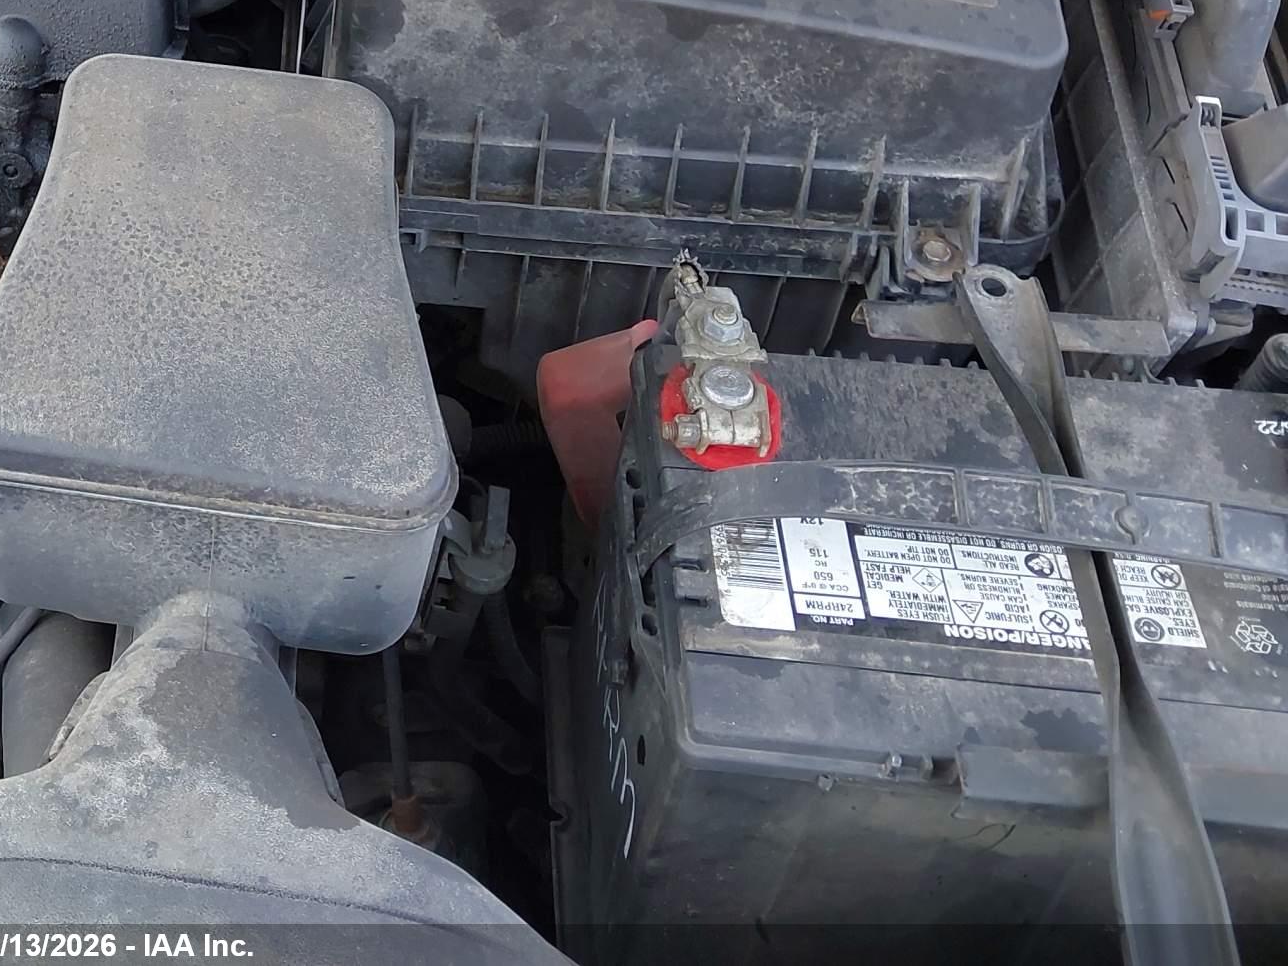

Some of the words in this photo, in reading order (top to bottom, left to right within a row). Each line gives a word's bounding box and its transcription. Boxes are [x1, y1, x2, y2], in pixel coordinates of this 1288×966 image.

[918, 533, 967, 545] DISASSEMBLE
[810, 548, 828, 558] 115
[863, 548, 898, 559] BATTERY.
[905, 545, 917, 553] TIP.
[920, 546, 935, 554] NOT
[937, 548, 948, 556] DO
[900, 552, 919, 561] OPEN
[923, 554, 937, 563] NOT
[940, 556, 950, 565] DO
[862, 562, 885, 572] FAST.
[983, 560, 996, 569] ALL
[999, 561, 1019, 571] READ
[1120, 565, 1144, 574] REACH
[889, 565, 910, 575] HELP
[813, 571, 832, 582] 650
[863, 571, 903, 582] MEDICAL
[957, 572, 986, 584] BURNS.
[989, 576, 1018, 586] SEVERE
[1130, 574, 1148, 583] KEEP
[830, 583, 848, 592] CCA
[866, 580, 882, 589] GET
[964, 581, 975, 590] OR
[977, 583, 1020, 595] BLINDNESS
[885, 590, 919, 601] WATER.
[922, 593, 945, 603] WITH
[979, 592, 1004, 601] CAUSE
[1008, 595, 1023, 603] CAN
[1175, 591, 1186, 600] OR
[888, 598, 947, 612] IMMEDIATELY
[1048, 601, 1078, 611] SPARKS
[1146, 596, 1170, 606] CAUSE
[1173, 599, 1189, 607] CAN
[805, 600, 853, 613] 24RPRM
[1004, 603, 1024, 612] ACID
[1143, 605, 1192, 617] EXPLOSIVE
[897, 608, 919, 619] EYES
[922, 611, 949, 622] FLUSH
[984, 611, 1028, 623] SULFURIC
[810, 615, 826, 624] NO.
[829, 616, 853, 626] PART
[1168, 617, 1195, 628] EYES.
[944, 624, 1090, 650] ANGER/POISON
[1167, 627, 1199, 638] SHIELD
